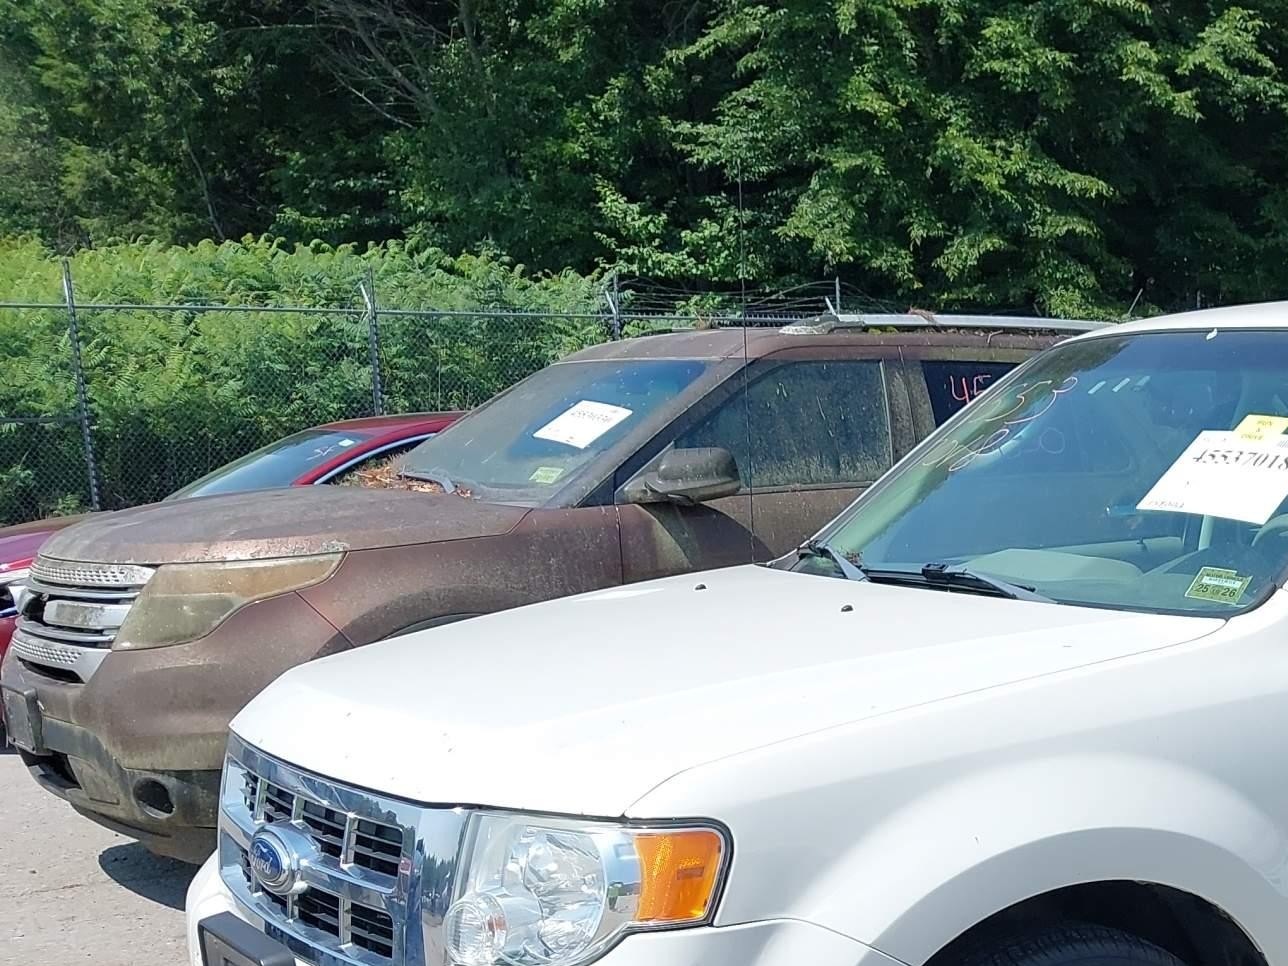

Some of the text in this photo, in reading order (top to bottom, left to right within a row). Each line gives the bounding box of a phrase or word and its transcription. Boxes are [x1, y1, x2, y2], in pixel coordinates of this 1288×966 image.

[1194, 583, 1211, 593] 25
[1221, 587, 1238, 598] 26
[251, 842, 273, 874] Ford
